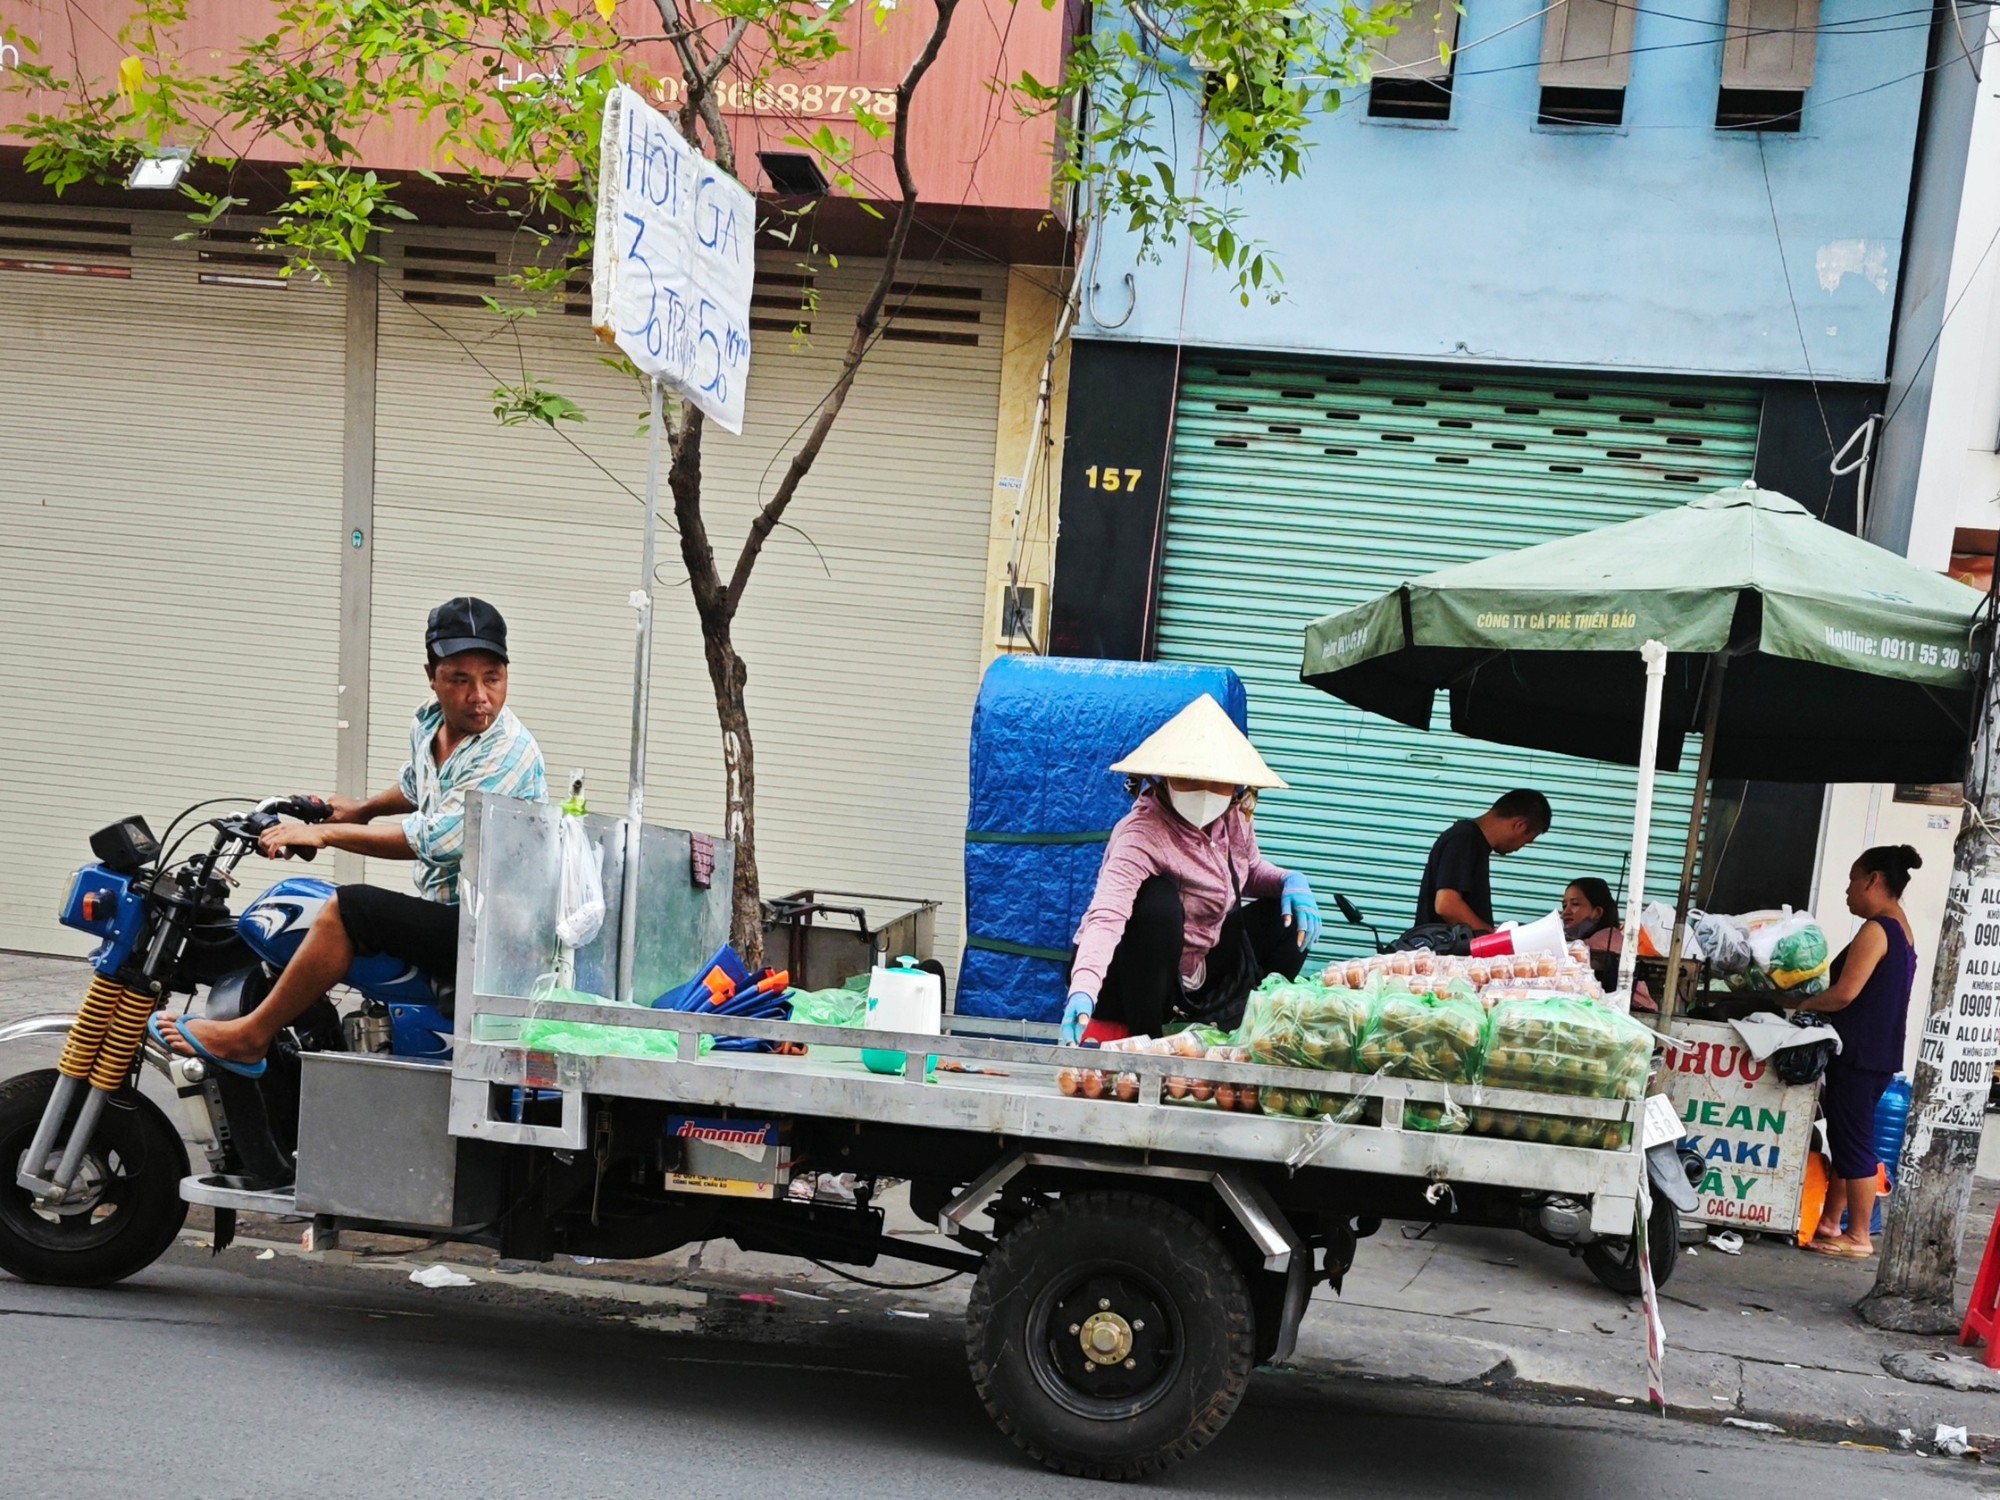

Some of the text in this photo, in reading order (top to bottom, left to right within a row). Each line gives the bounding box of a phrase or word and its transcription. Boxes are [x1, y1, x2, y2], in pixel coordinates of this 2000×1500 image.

[1085, 464, 1142, 492] 157
[1477, 611, 1510, 629] CÔNG
[1513, 614, 1527, 629] TY
[1547, 611, 1572, 629] PHÊ
[1824, 625, 1878, 656] Hotline:
[1880, 637, 1915, 662] 0911
[1918, 643, 1939, 666] 55
[1940, 647, 1960, 670] 30
[1965, 959, 1989, 976] ALO
[1960, 993, 1992, 1018] 0909
[1956, 1025, 1979, 1042] ALO
[1950, 1060, 1982, 1083] 0909
[1680, 1098, 1786, 1135] JEAN
[1676, 1135, 1780, 1169] KAKI
[1697, 1165, 1758, 1200] ÂY
